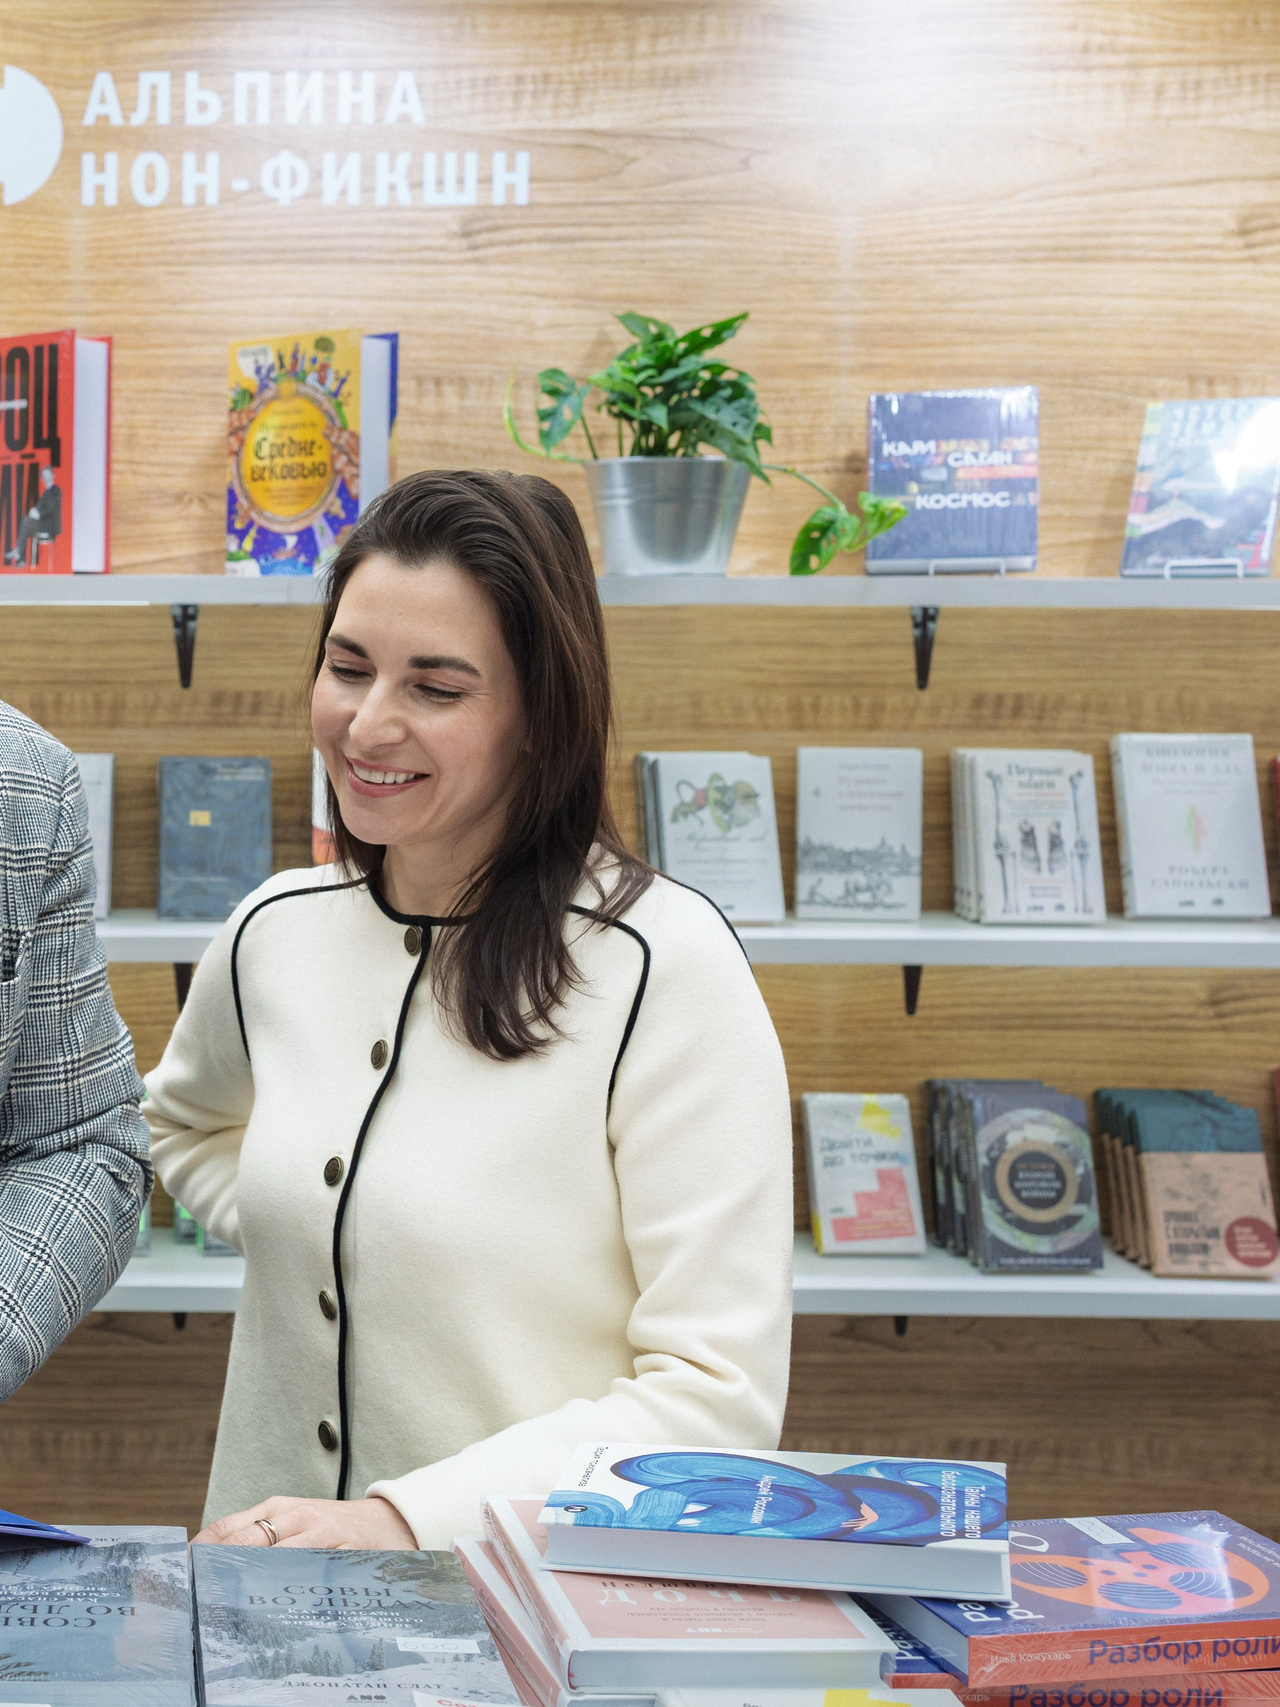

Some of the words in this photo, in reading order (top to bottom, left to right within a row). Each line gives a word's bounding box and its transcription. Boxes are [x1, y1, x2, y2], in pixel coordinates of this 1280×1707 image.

[82, 70, 426, 126] АЛЬПИНА
[81, 150, 532, 207] НОН-ФИКШН
[915, 491, 1011, 510] КОСМОС
[939, 1470, 962, 1538] бессознательного
[964, 1485, 987, 1508] Тайны
[964, 1509, 982, 1540] нашего
[283, 1584, 394, 1598] СОВЫ
[85, 1605, 138, 1616] ВО
[247, 1595, 297, 1606] ВО
[313, 1597, 436, 1610] ЛЬДАХ
[989, 1652, 1016, 1665] Илья
[1018, 1650, 1072, 1665] Кожухарь
[1089, 1636, 1208, 1666] Разбор
[282, 1680, 388, 1689] ДЖОНАТАН
[956, 1693, 990, 1704] ухарь
[1008, 1684, 1135, 1707] Разбор
[1139, 1686, 1224, 1707] роли
